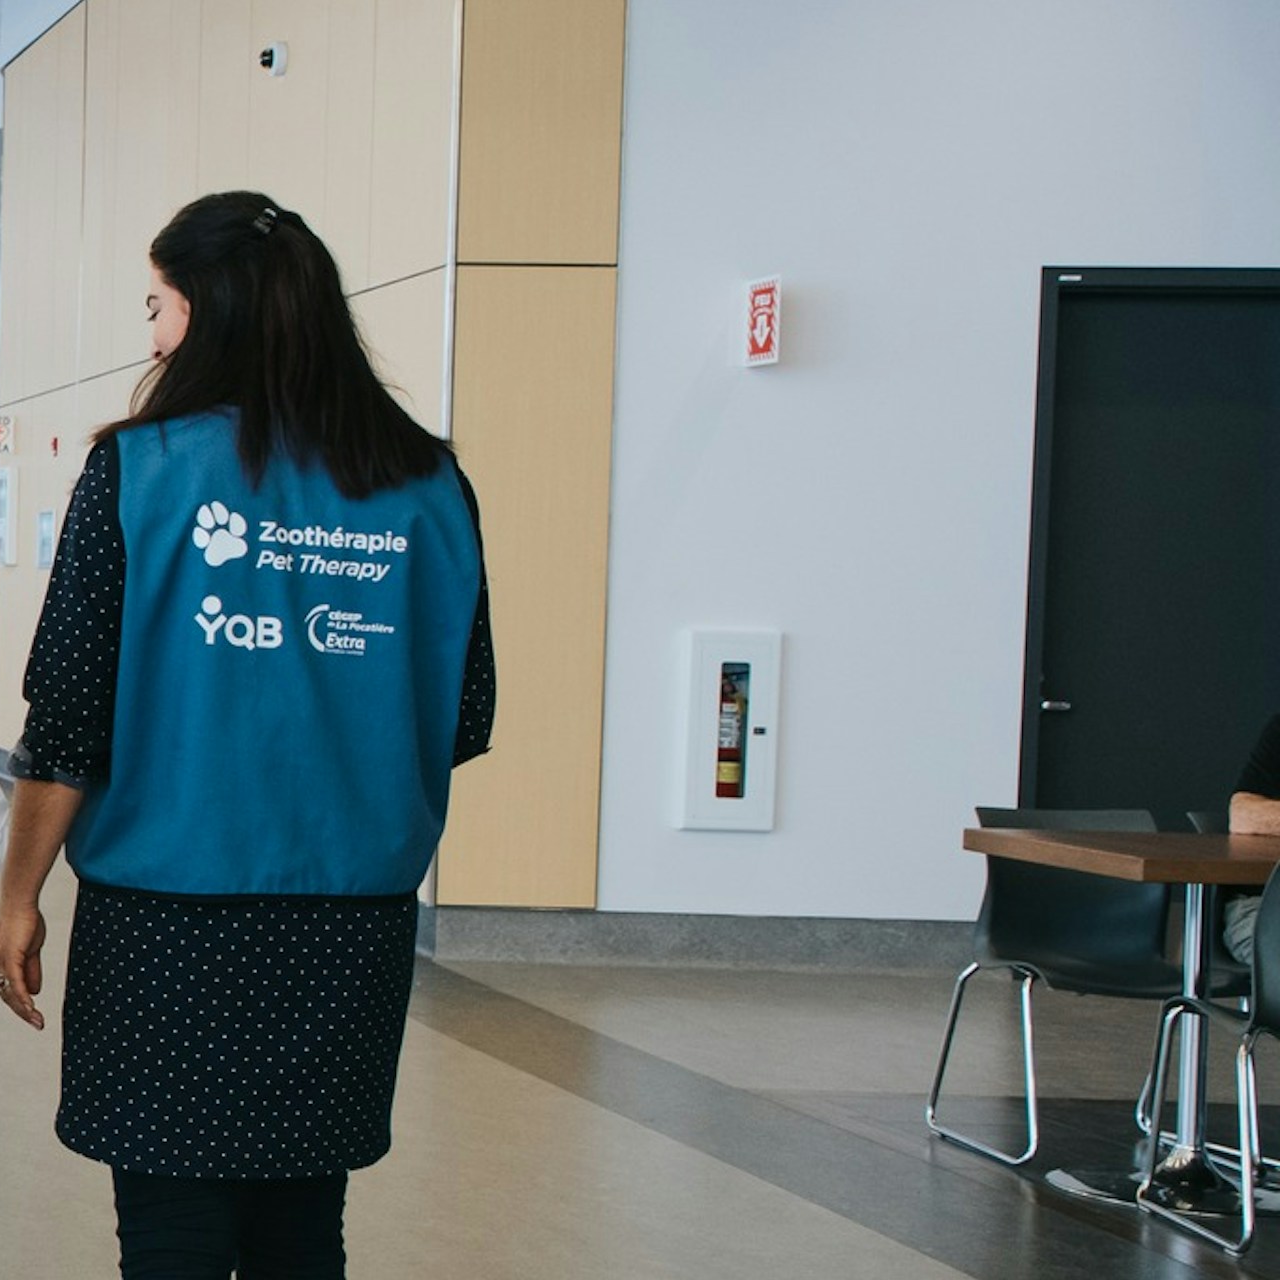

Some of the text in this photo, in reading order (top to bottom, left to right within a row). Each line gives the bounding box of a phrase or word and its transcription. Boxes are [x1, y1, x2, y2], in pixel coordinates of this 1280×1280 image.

[258, 520, 408, 555] Zoothérapie
[256, 550, 391, 582] Pet Therapy
[194, 595, 284, 651] YQB
[325, 631, 366, 650] Extra
